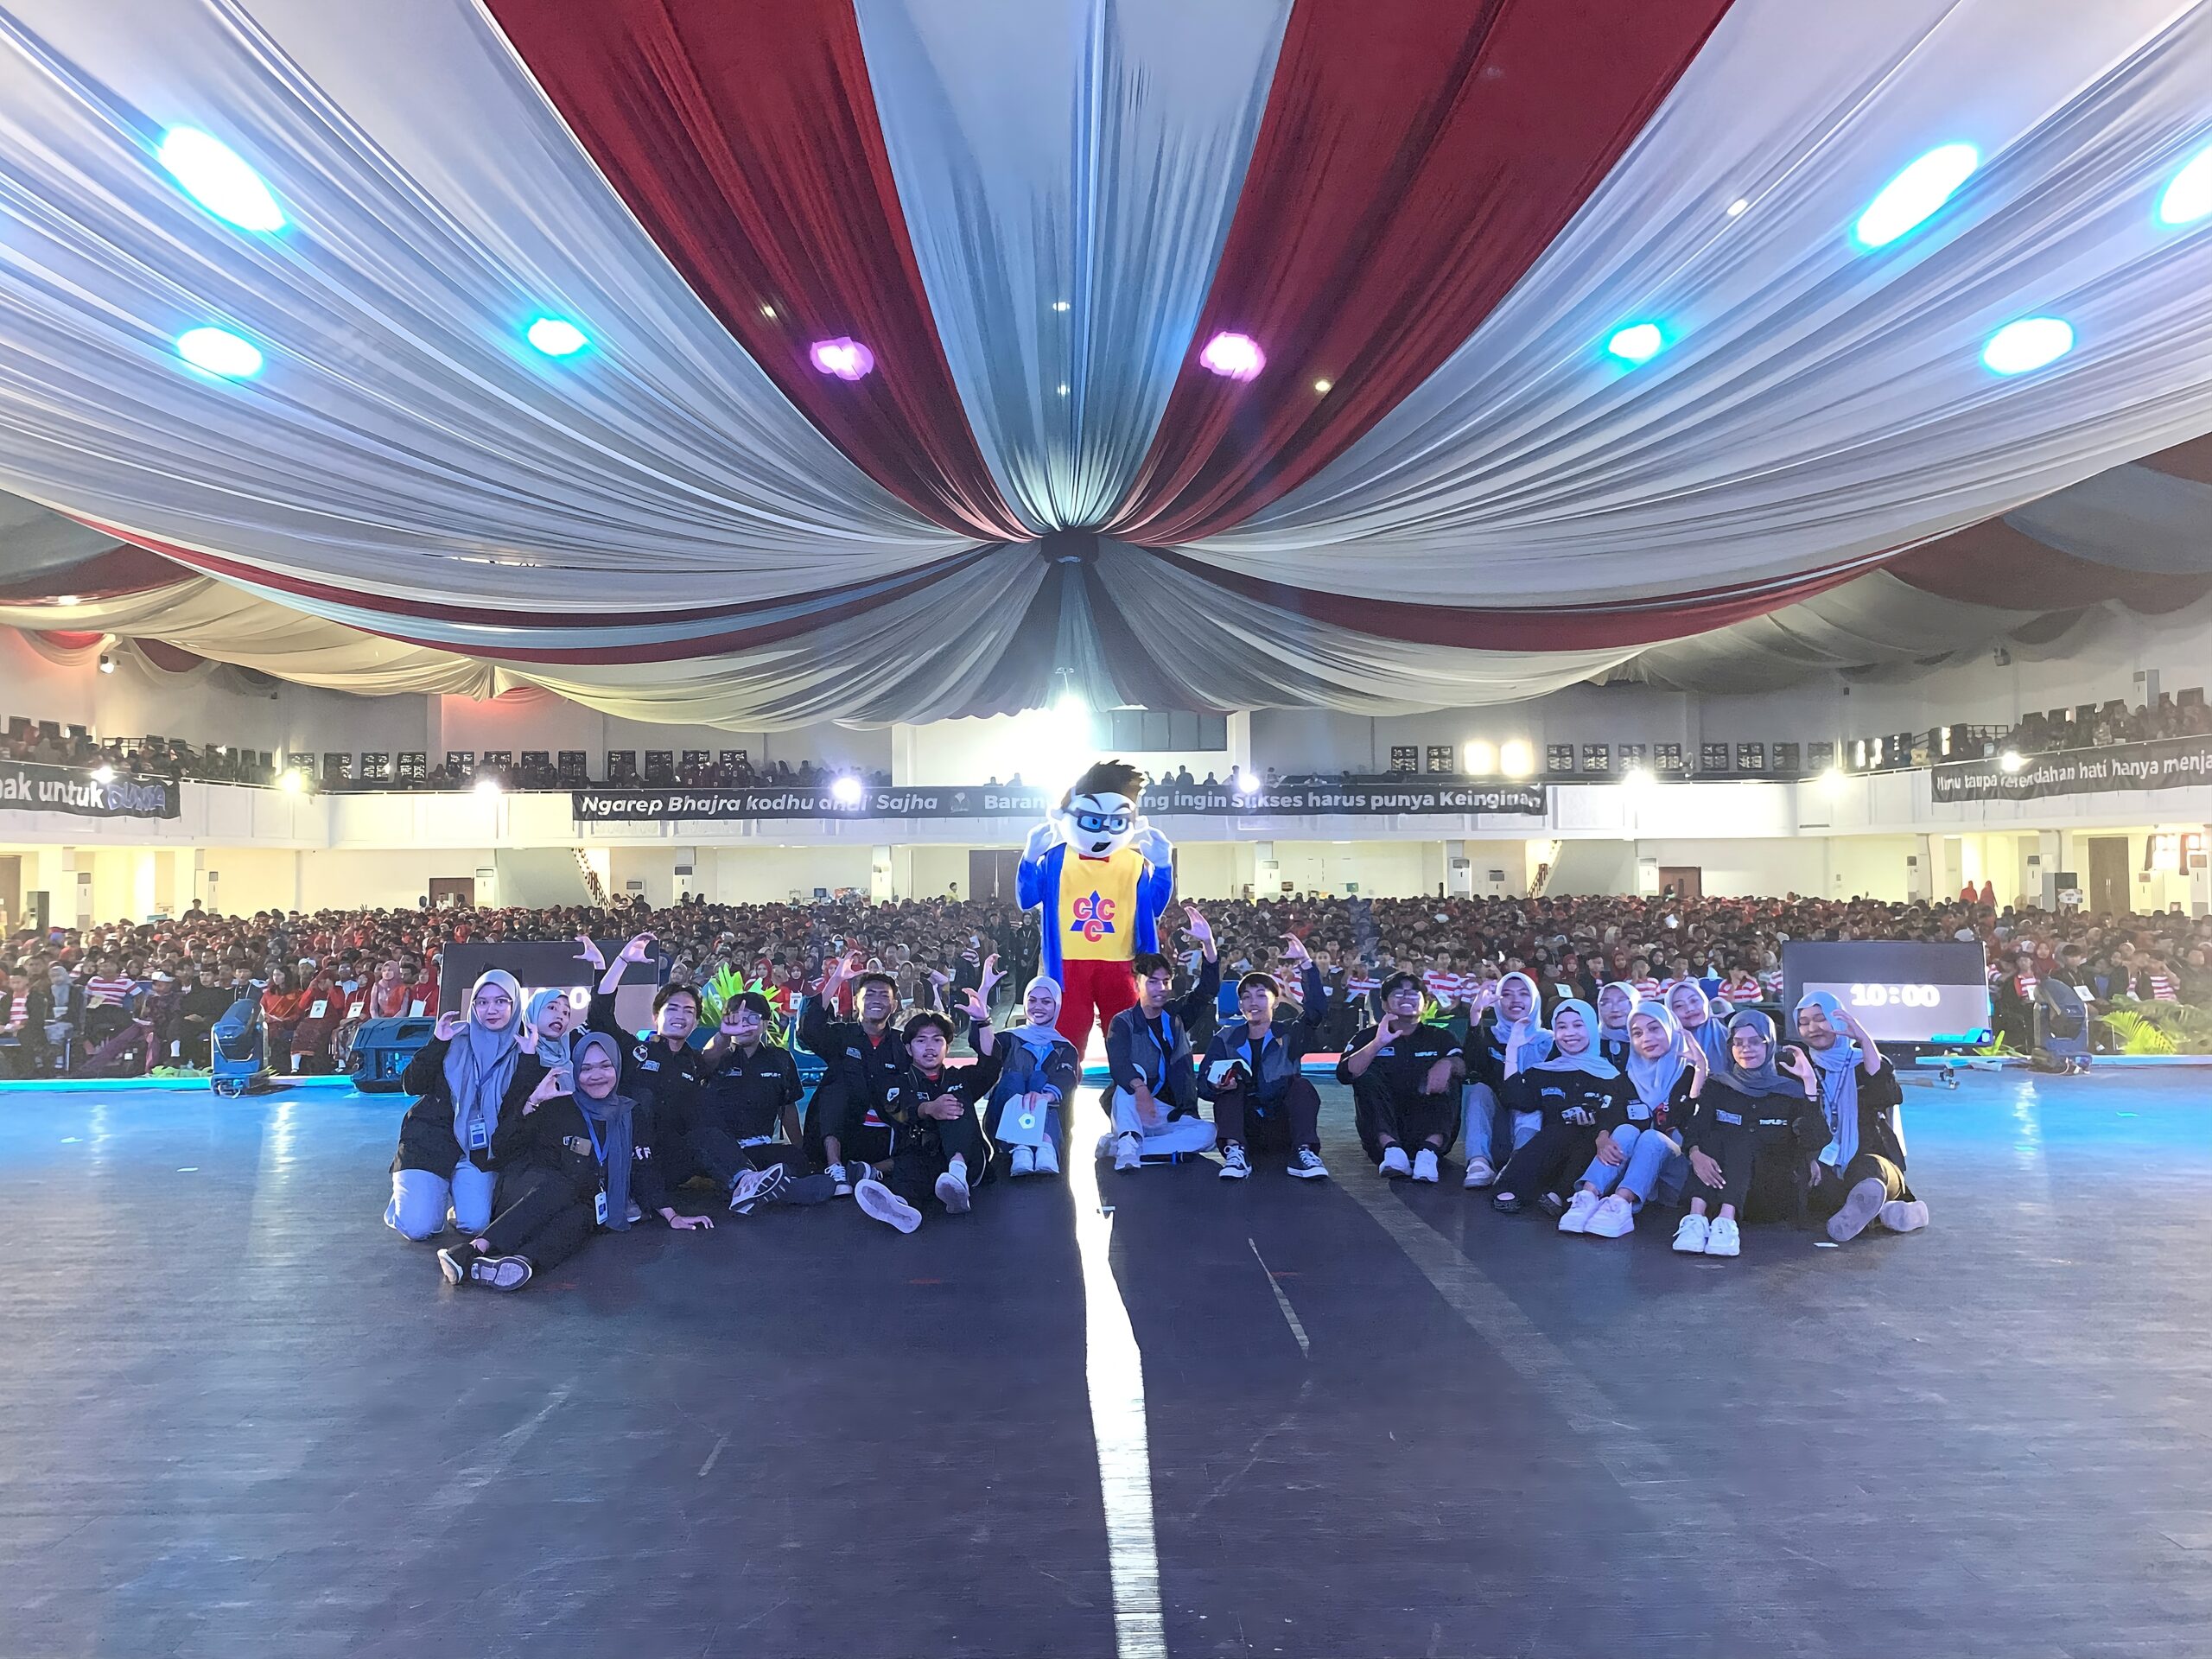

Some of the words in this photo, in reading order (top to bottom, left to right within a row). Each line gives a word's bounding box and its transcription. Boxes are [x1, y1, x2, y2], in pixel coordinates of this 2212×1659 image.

[2079, 759, 2107, 779] hati
[2112, 759, 2158, 779] hanya
[0, 772, 32, 801] ak
[39, 780, 105, 809] untuk
[984, 794, 1047, 810] Baran
[1174, 791, 1226, 810] ingin
[1231, 792, 1303, 809] Sukses
[1308, 791, 1365, 808] harus
[1370, 794, 1435, 810] punya
[1440, 790, 1541, 809] Keinginan
[582, 797, 663, 815] Ngarep
[668, 795, 741, 815] Bhajra
[746, 794, 815, 810] kodhu
[876, 794, 938, 813] Sajha
[1850, 983, 1941, 1007] 10:00
